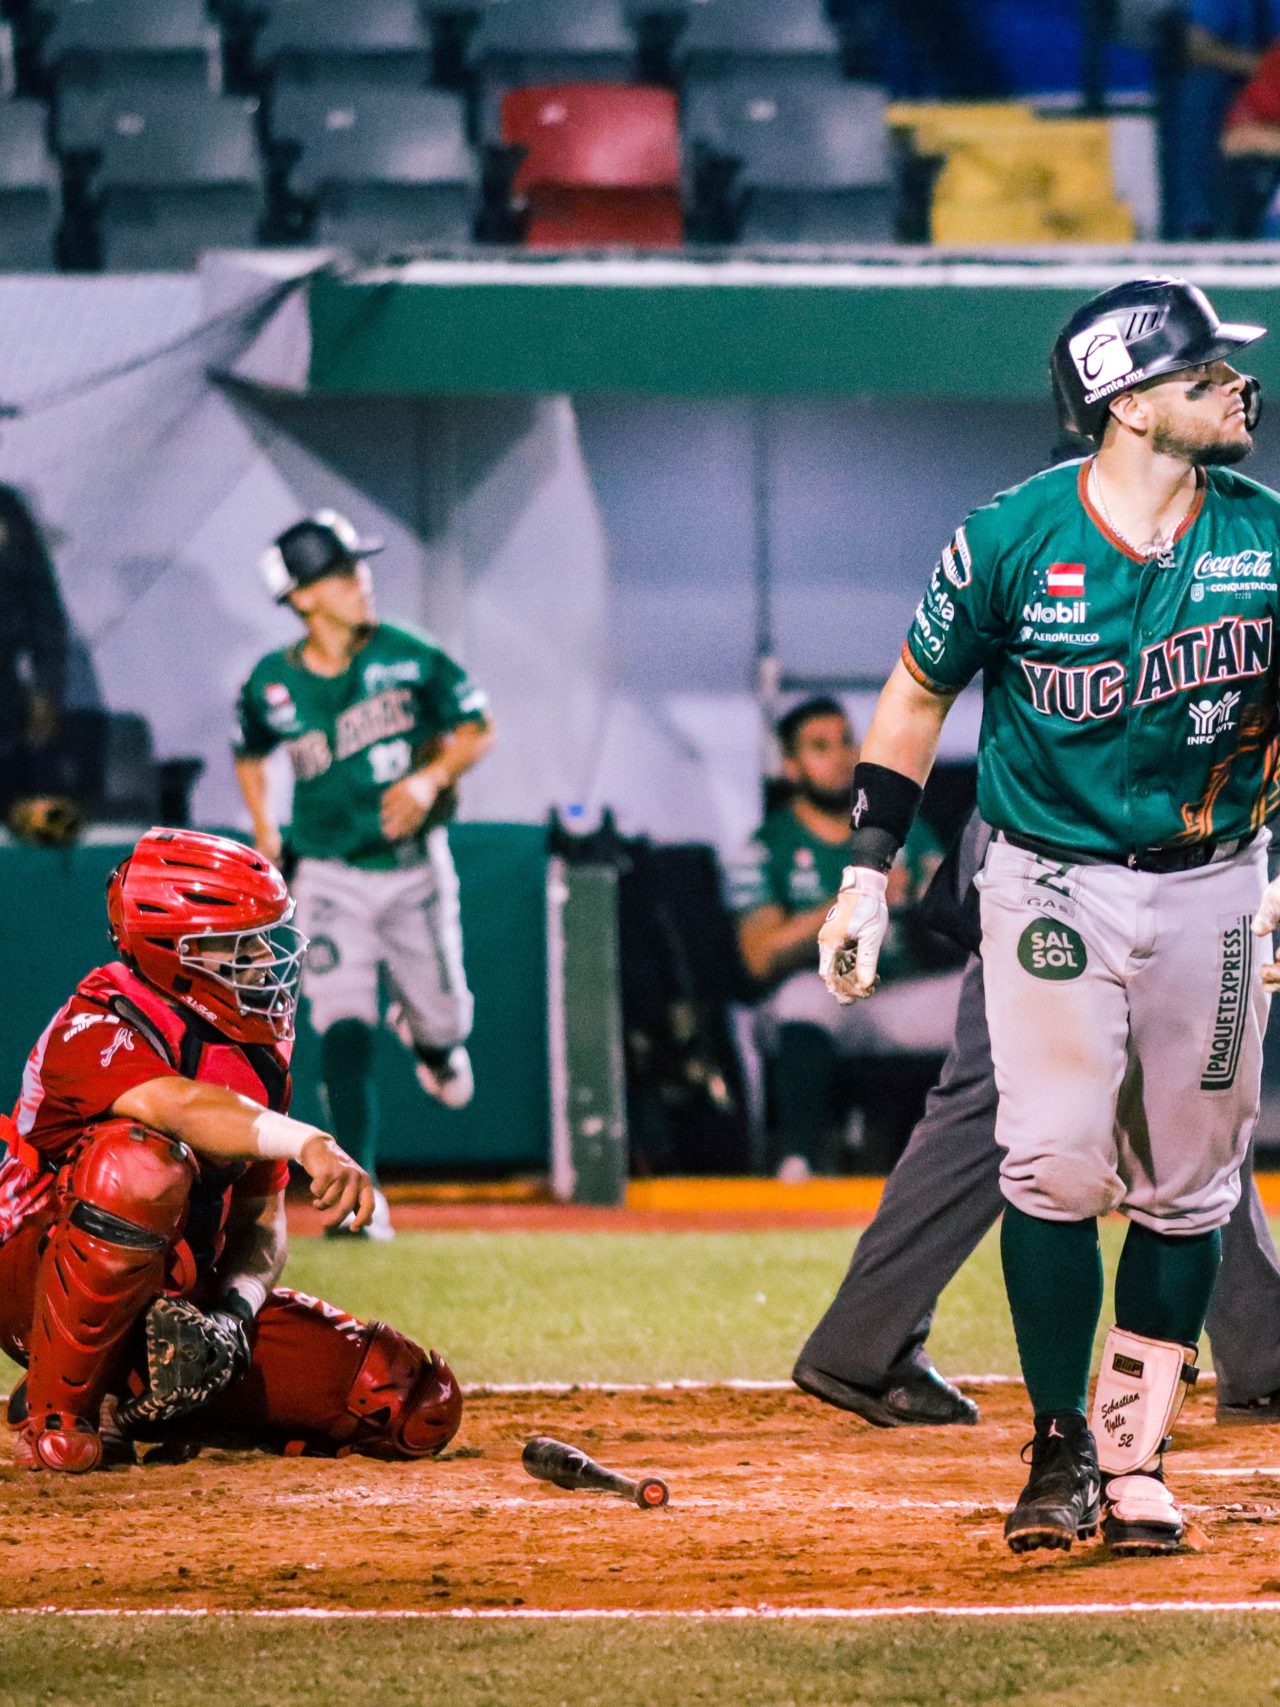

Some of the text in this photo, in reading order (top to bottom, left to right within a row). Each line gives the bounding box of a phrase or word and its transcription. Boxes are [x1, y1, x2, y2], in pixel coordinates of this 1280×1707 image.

[1084, 367, 1145, 404] caliente.mx
[1210, 581, 1278, 593] CONQUISTADOR
[1023, 601, 1087, 624] Mobil
[1033, 631, 1100, 643] AEROMEXICO
[1027, 897, 1069, 914] GAS
[1030, 930, 1074, 950] SAL
[1032, 949, 1078, 969] SOL
[1206, 928, 1241, 1073] PAQUETEXPRESS
[1101, 1391, 1140, 1419] Sebastian
[1118, 1433, 1134, 1448] 52
